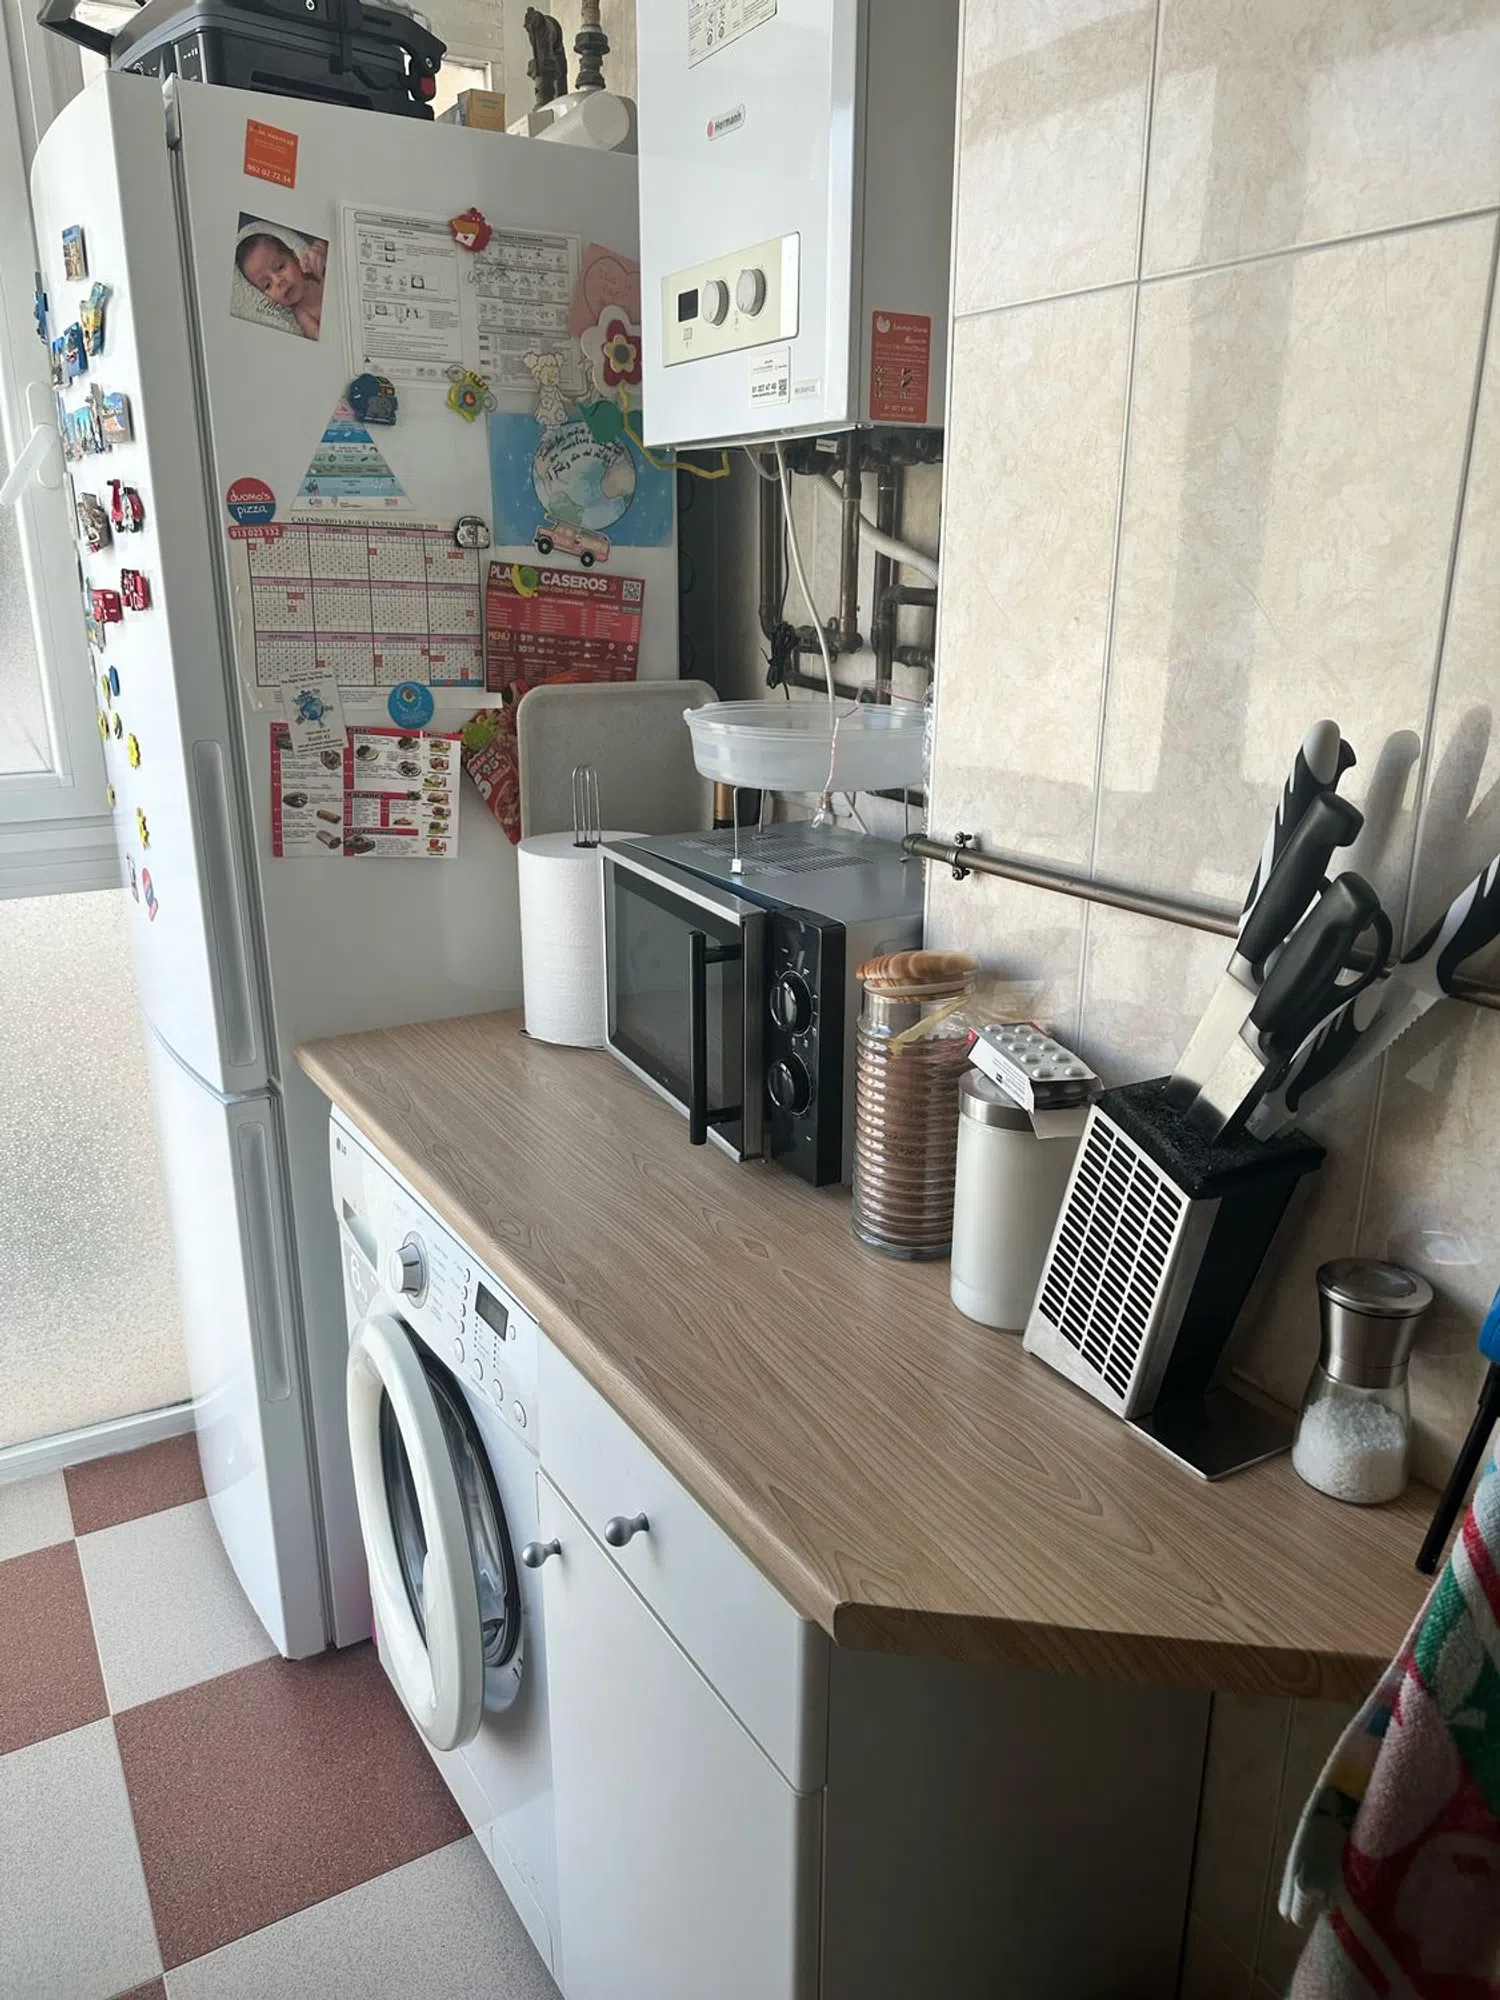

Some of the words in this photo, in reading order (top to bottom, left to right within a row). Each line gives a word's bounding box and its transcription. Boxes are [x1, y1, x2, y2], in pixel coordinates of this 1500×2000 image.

[715, 111, 742, 132] Hermann
[230, 490, 271, 503] duomo's
[237, 503, 268, 519] pizza
[264, 526, 281, 537] 132
[540, 572, 608, 592] CASEROS
